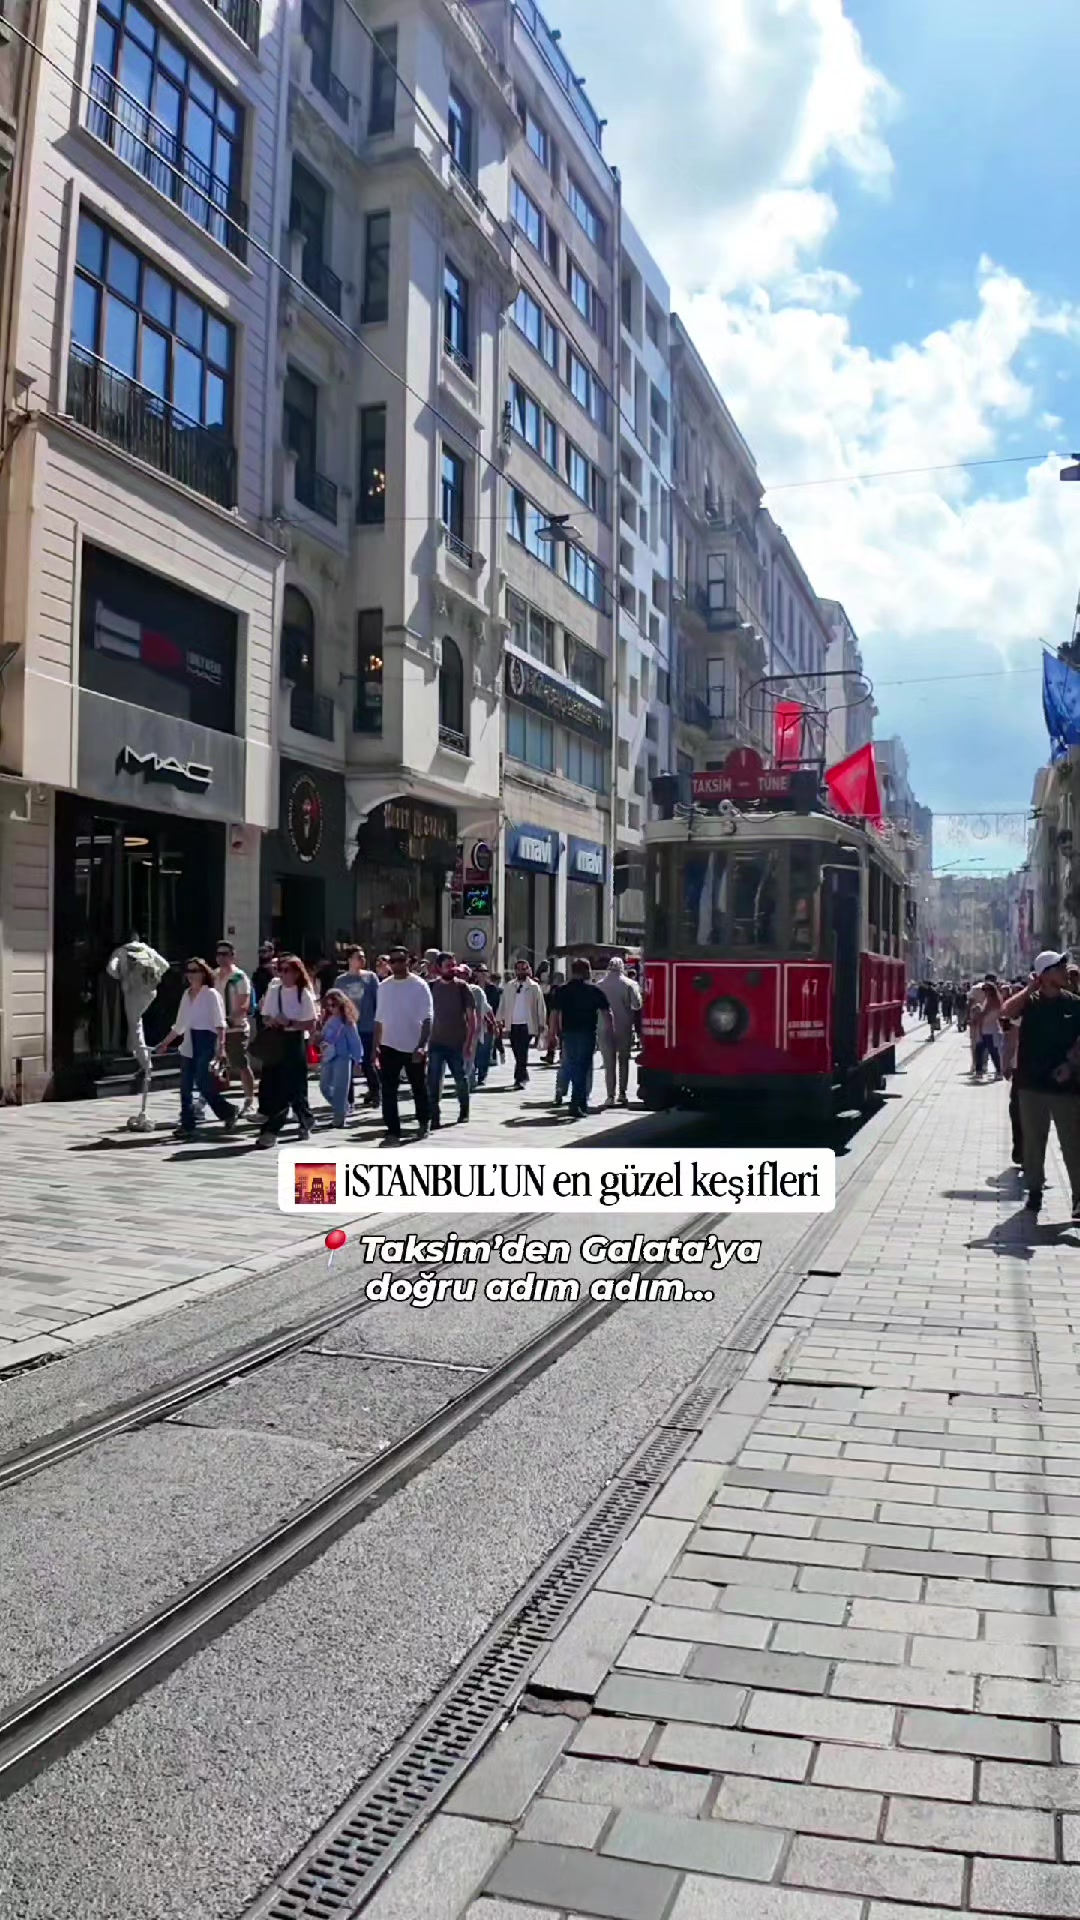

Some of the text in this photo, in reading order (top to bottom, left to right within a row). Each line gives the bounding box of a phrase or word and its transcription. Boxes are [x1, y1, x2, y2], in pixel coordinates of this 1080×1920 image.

[693, 774, 732, 793] TAKSİM
[519, 834, 552, 864] mavi
[576, 848, 603, 875] mavi
